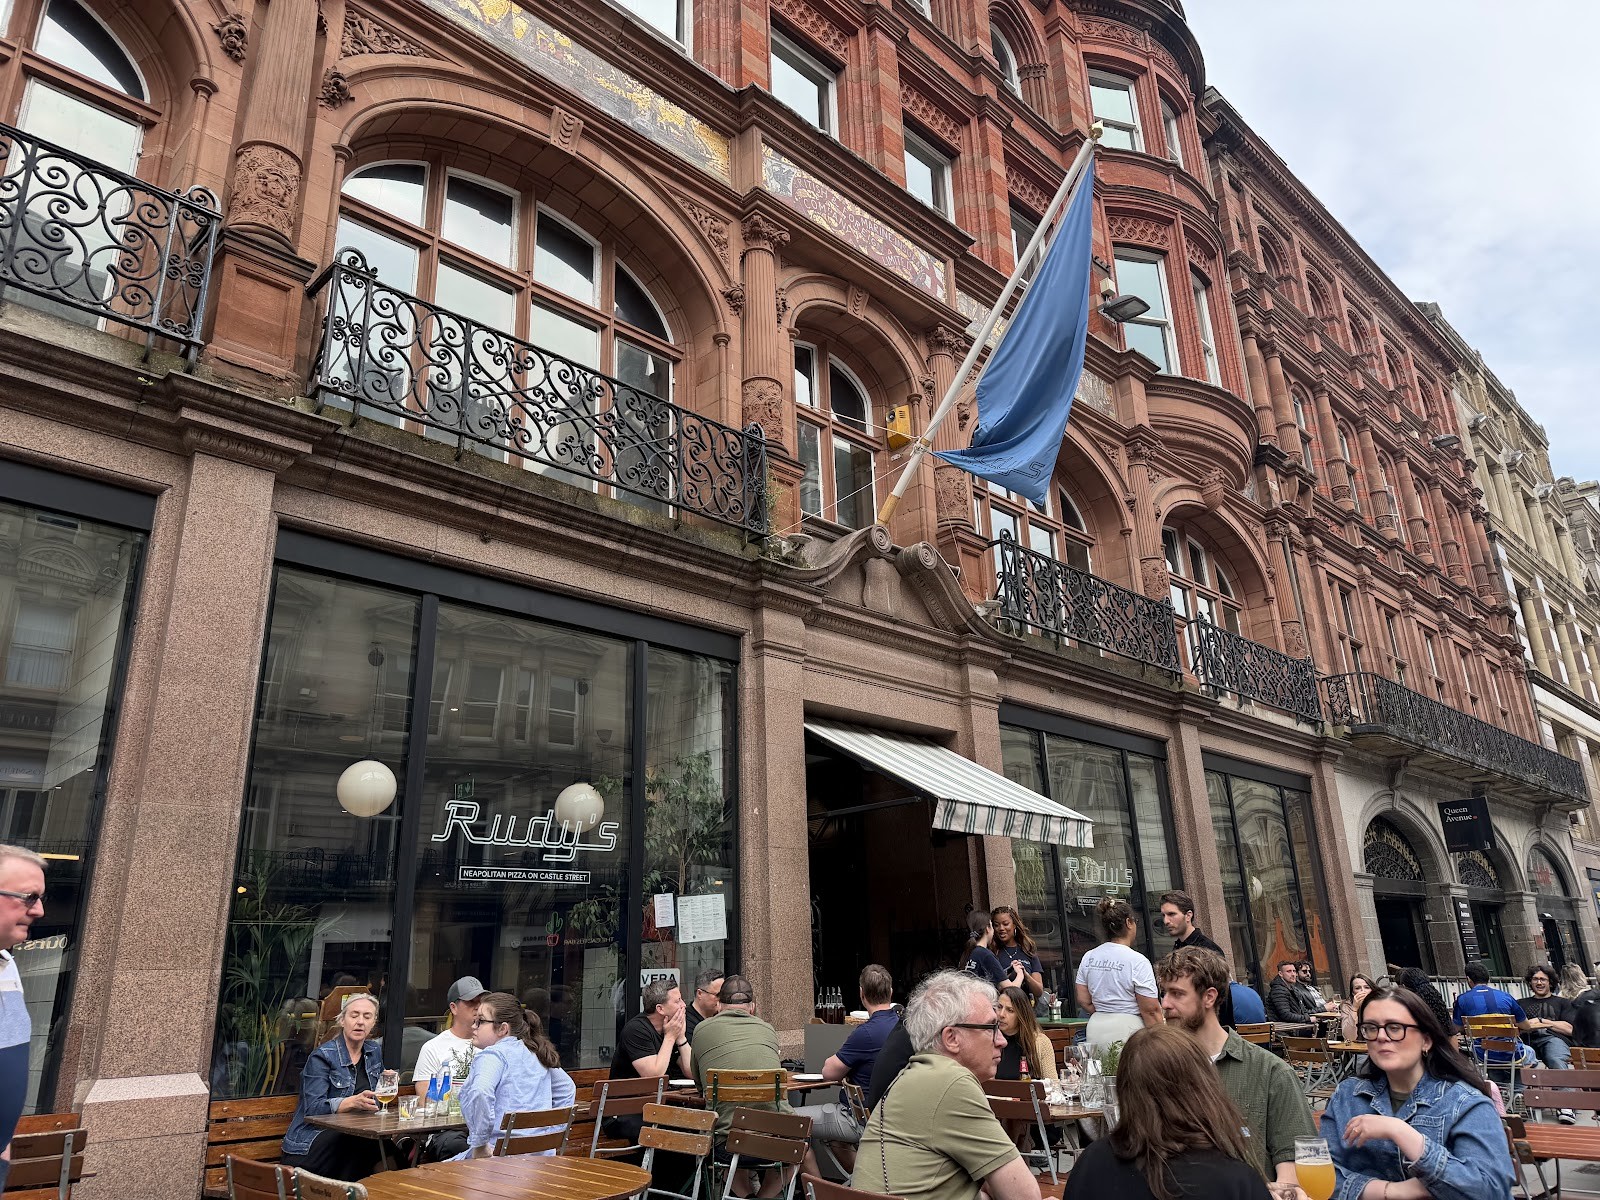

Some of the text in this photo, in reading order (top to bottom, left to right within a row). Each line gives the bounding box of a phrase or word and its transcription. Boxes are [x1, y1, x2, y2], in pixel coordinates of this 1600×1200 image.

[1444, 806, 1468, 816] Queen
[1445, 814, 1473, 823] Avenue
[431, 800, 619, 862] Rudy's
[463, 869, 587, 882] NEAPOLITAN PIZZA ON CASTLE STREET
[1065, 857, 1133, 894] Rudy's
